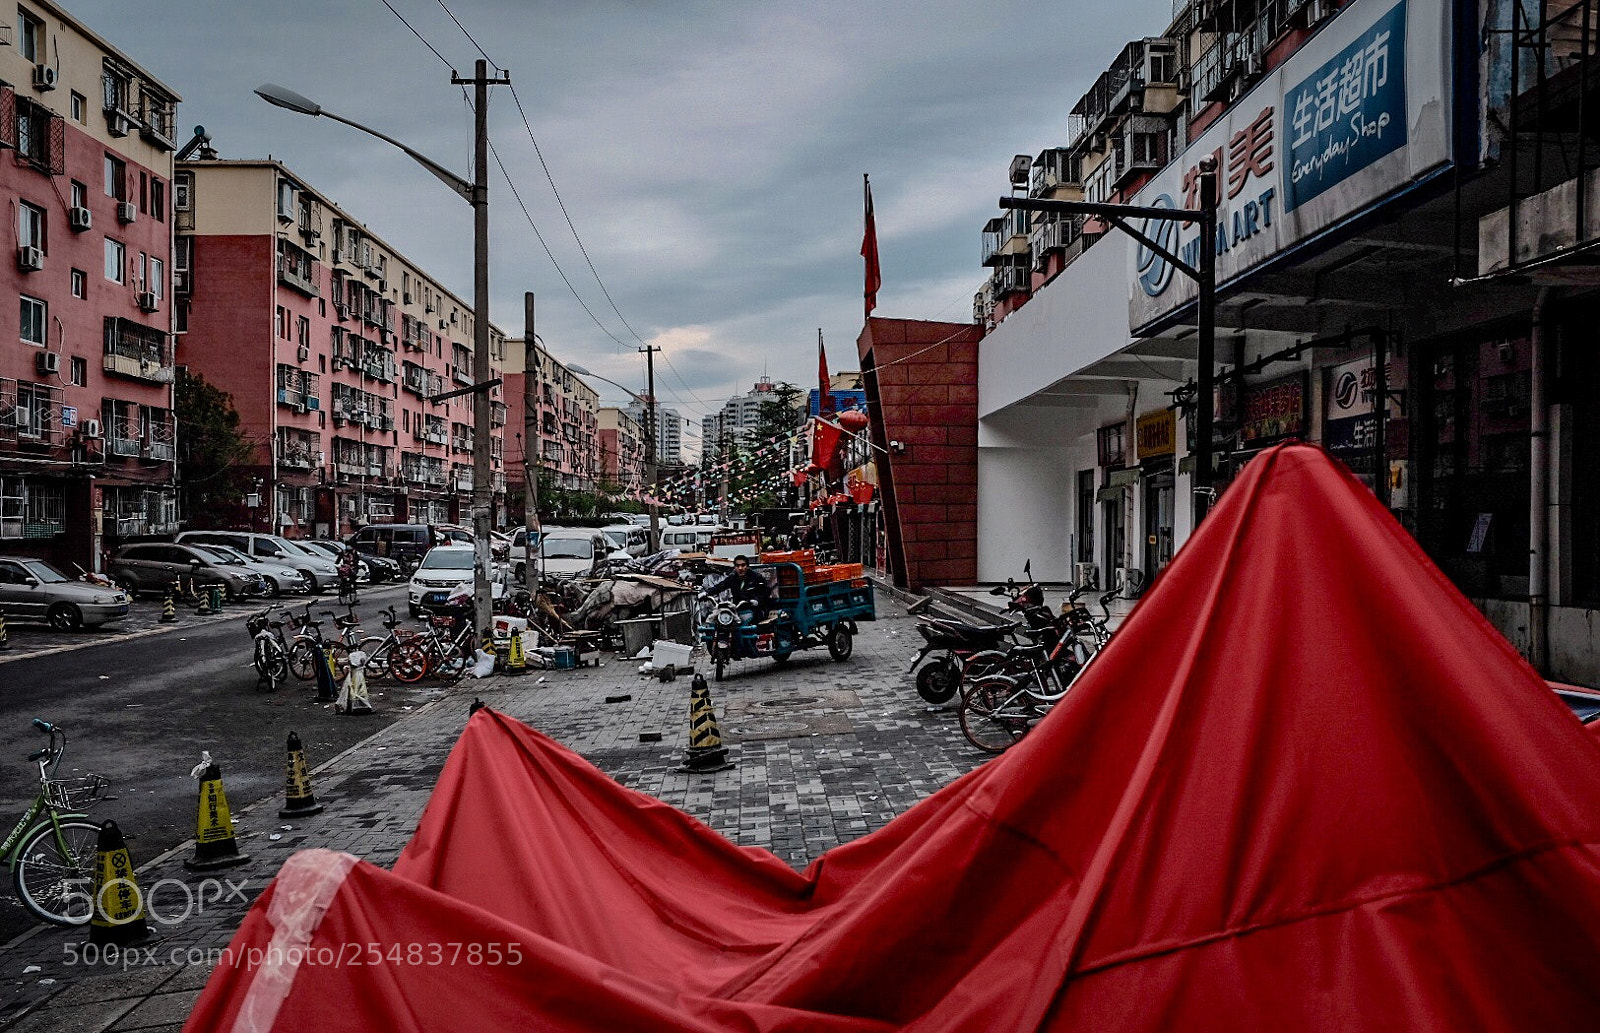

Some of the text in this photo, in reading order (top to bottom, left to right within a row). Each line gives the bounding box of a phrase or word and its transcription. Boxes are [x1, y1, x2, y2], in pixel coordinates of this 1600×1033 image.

[1292, 30, 1390, 150] 生活超市
[1292, 111, 1390, 184] Everyday Shop
[114, 868, 132, 909] 禁止停车
